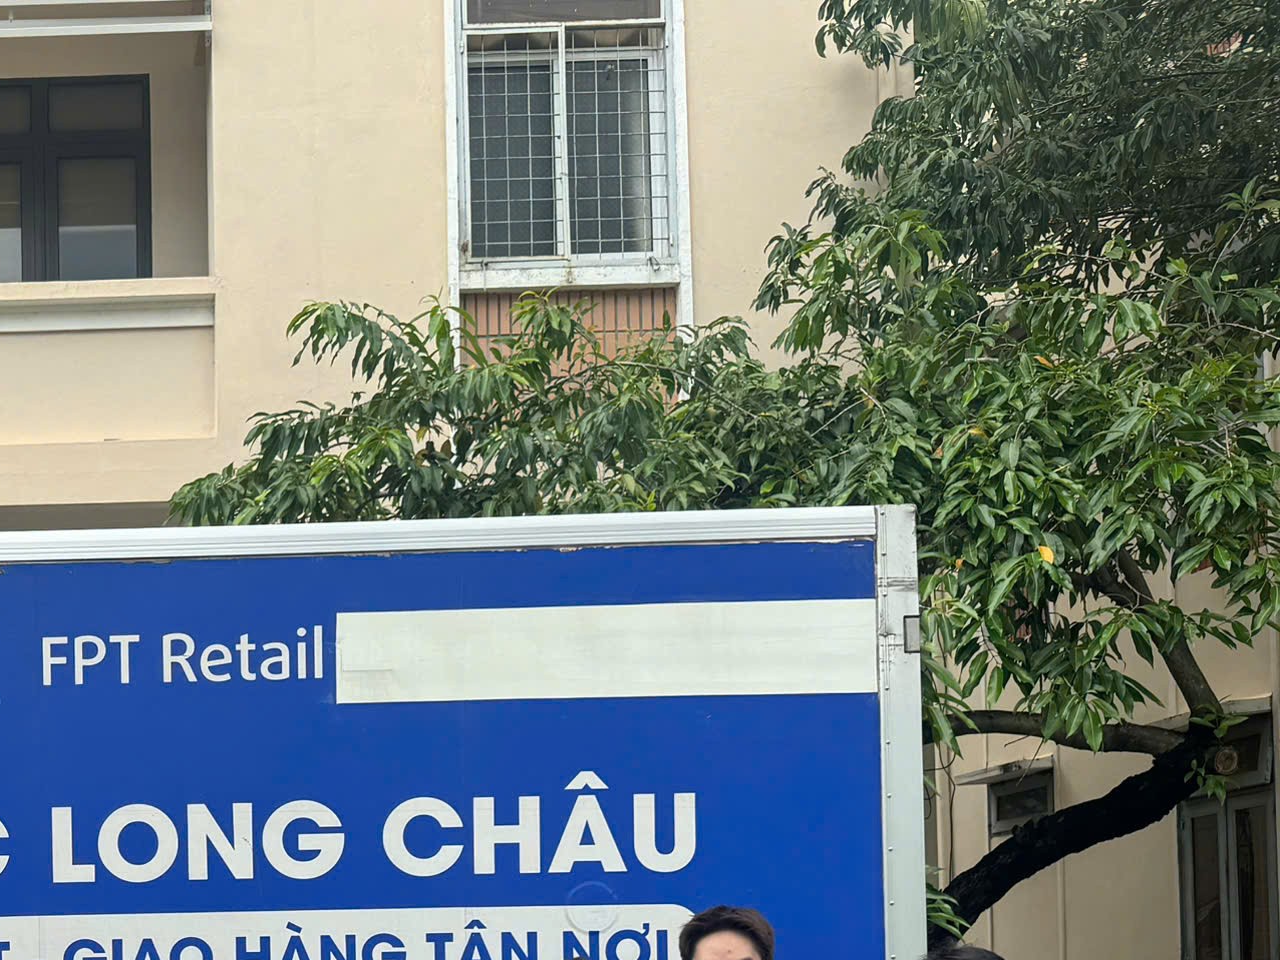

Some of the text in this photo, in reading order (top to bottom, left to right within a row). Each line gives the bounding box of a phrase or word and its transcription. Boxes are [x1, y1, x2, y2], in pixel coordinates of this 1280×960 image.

[41, 624, 324, 686] FPT Retail
[51, 799, 345, 884] LONG
[381, 770, 697, 877] CHÂU
